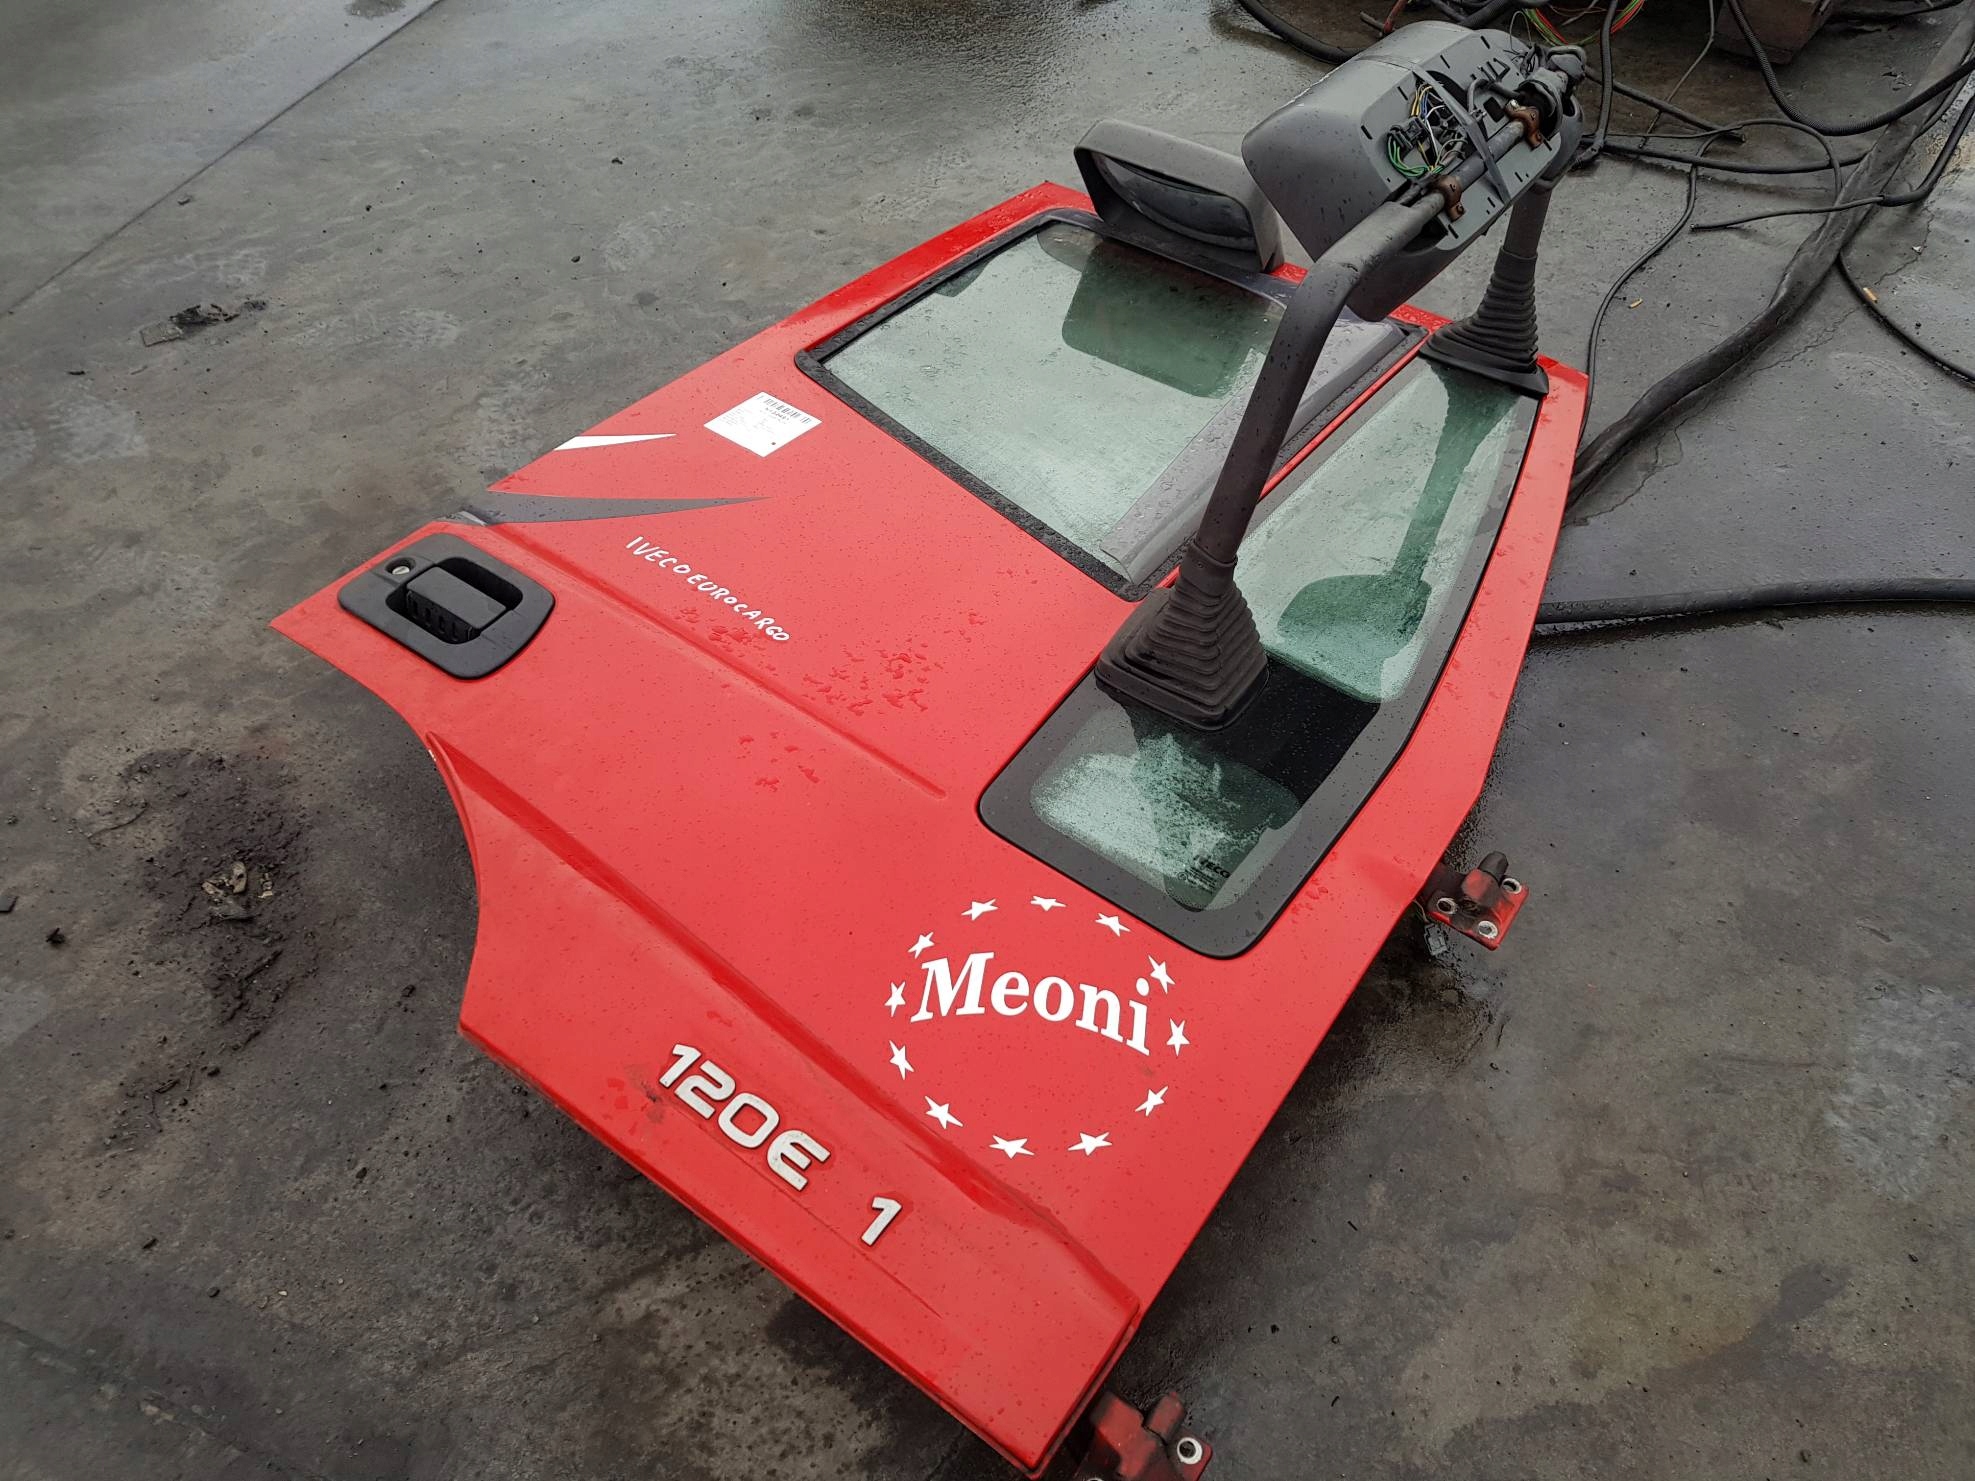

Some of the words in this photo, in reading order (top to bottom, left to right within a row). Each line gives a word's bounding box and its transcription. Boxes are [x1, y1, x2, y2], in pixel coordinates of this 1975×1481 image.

[625, 536, 692, 574] IVECO
[909, 951, 1150, 1056] Meoni
[659, 1043, 831, 1191] 120E
[861, 1196, 902, 1246] 1
